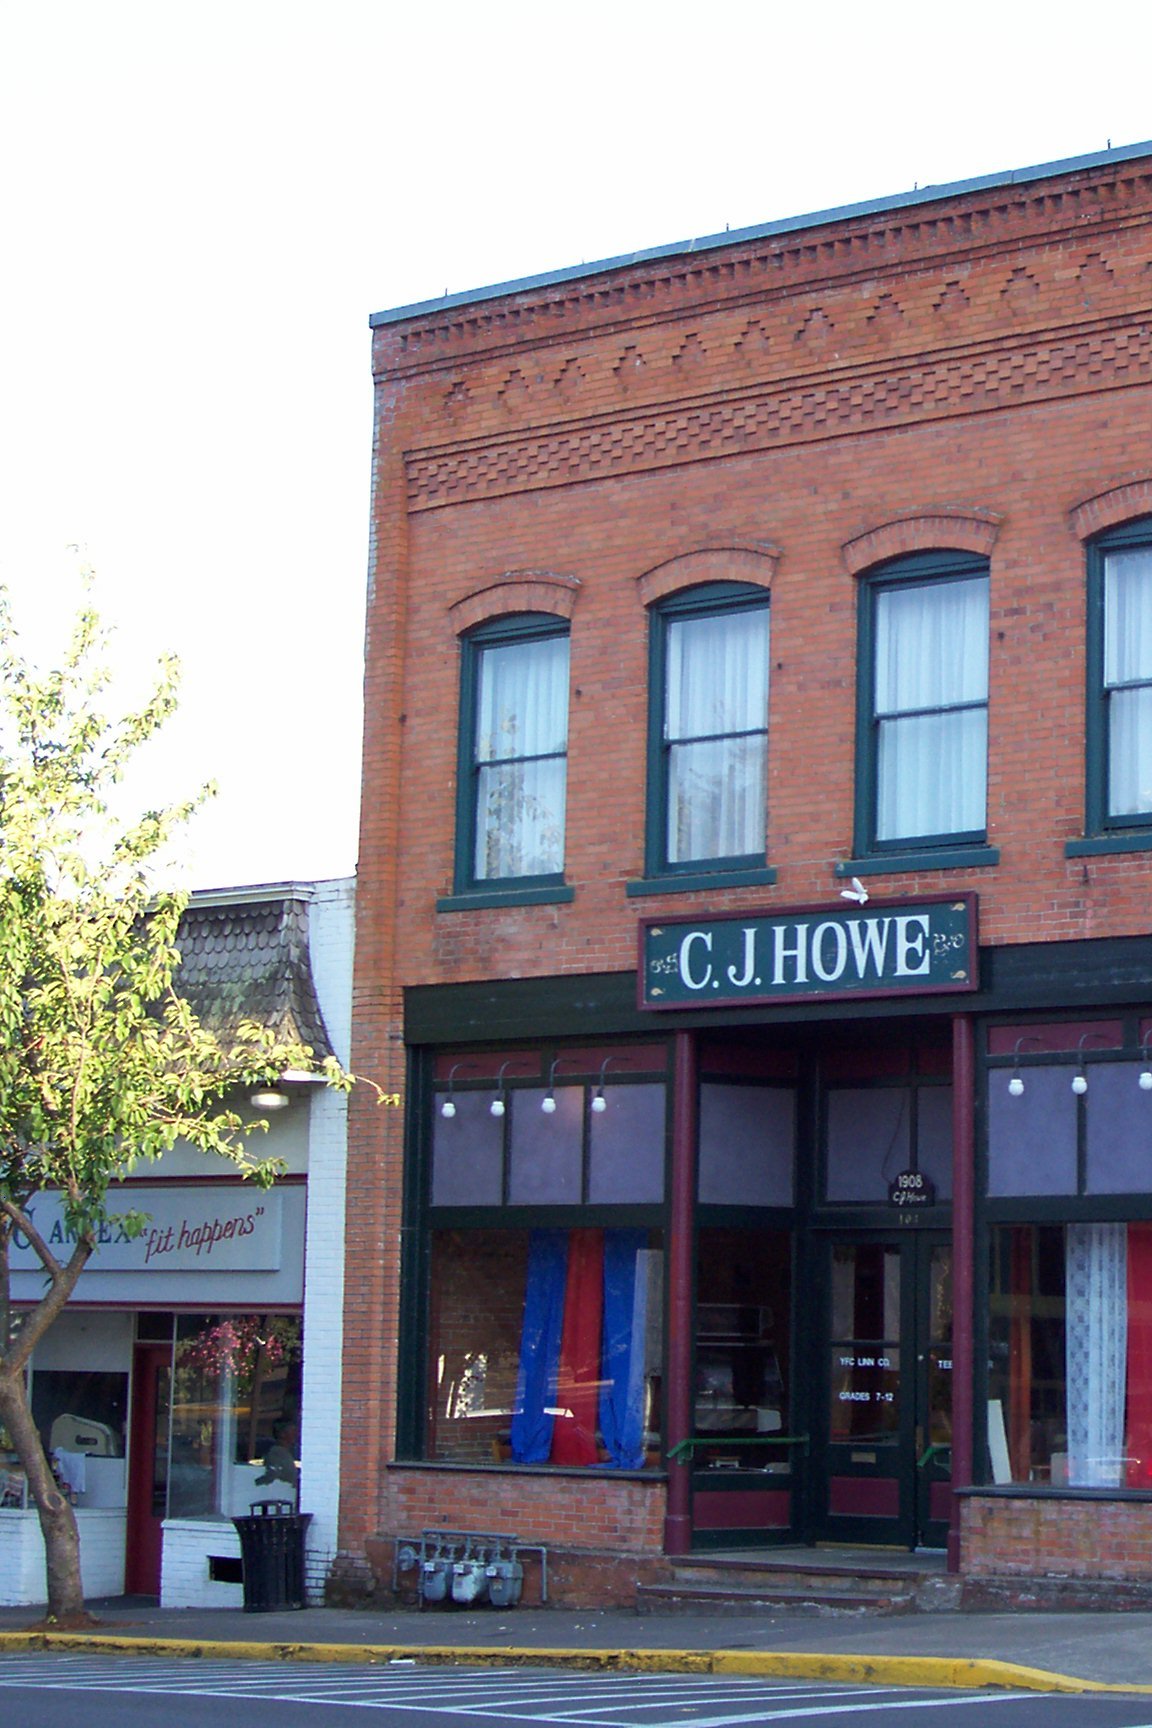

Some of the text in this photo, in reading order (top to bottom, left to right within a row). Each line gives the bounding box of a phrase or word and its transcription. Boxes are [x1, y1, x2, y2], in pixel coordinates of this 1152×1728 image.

[679, 914, 930, 990] C. J. HOWE
[898, 1174, 923, 1188] 1908
[857, 1357, 874, 1367] LINN
[937, 1359, 953, 1369] TEE
[839, 1392, 894, 1401] GRADES 7-12
